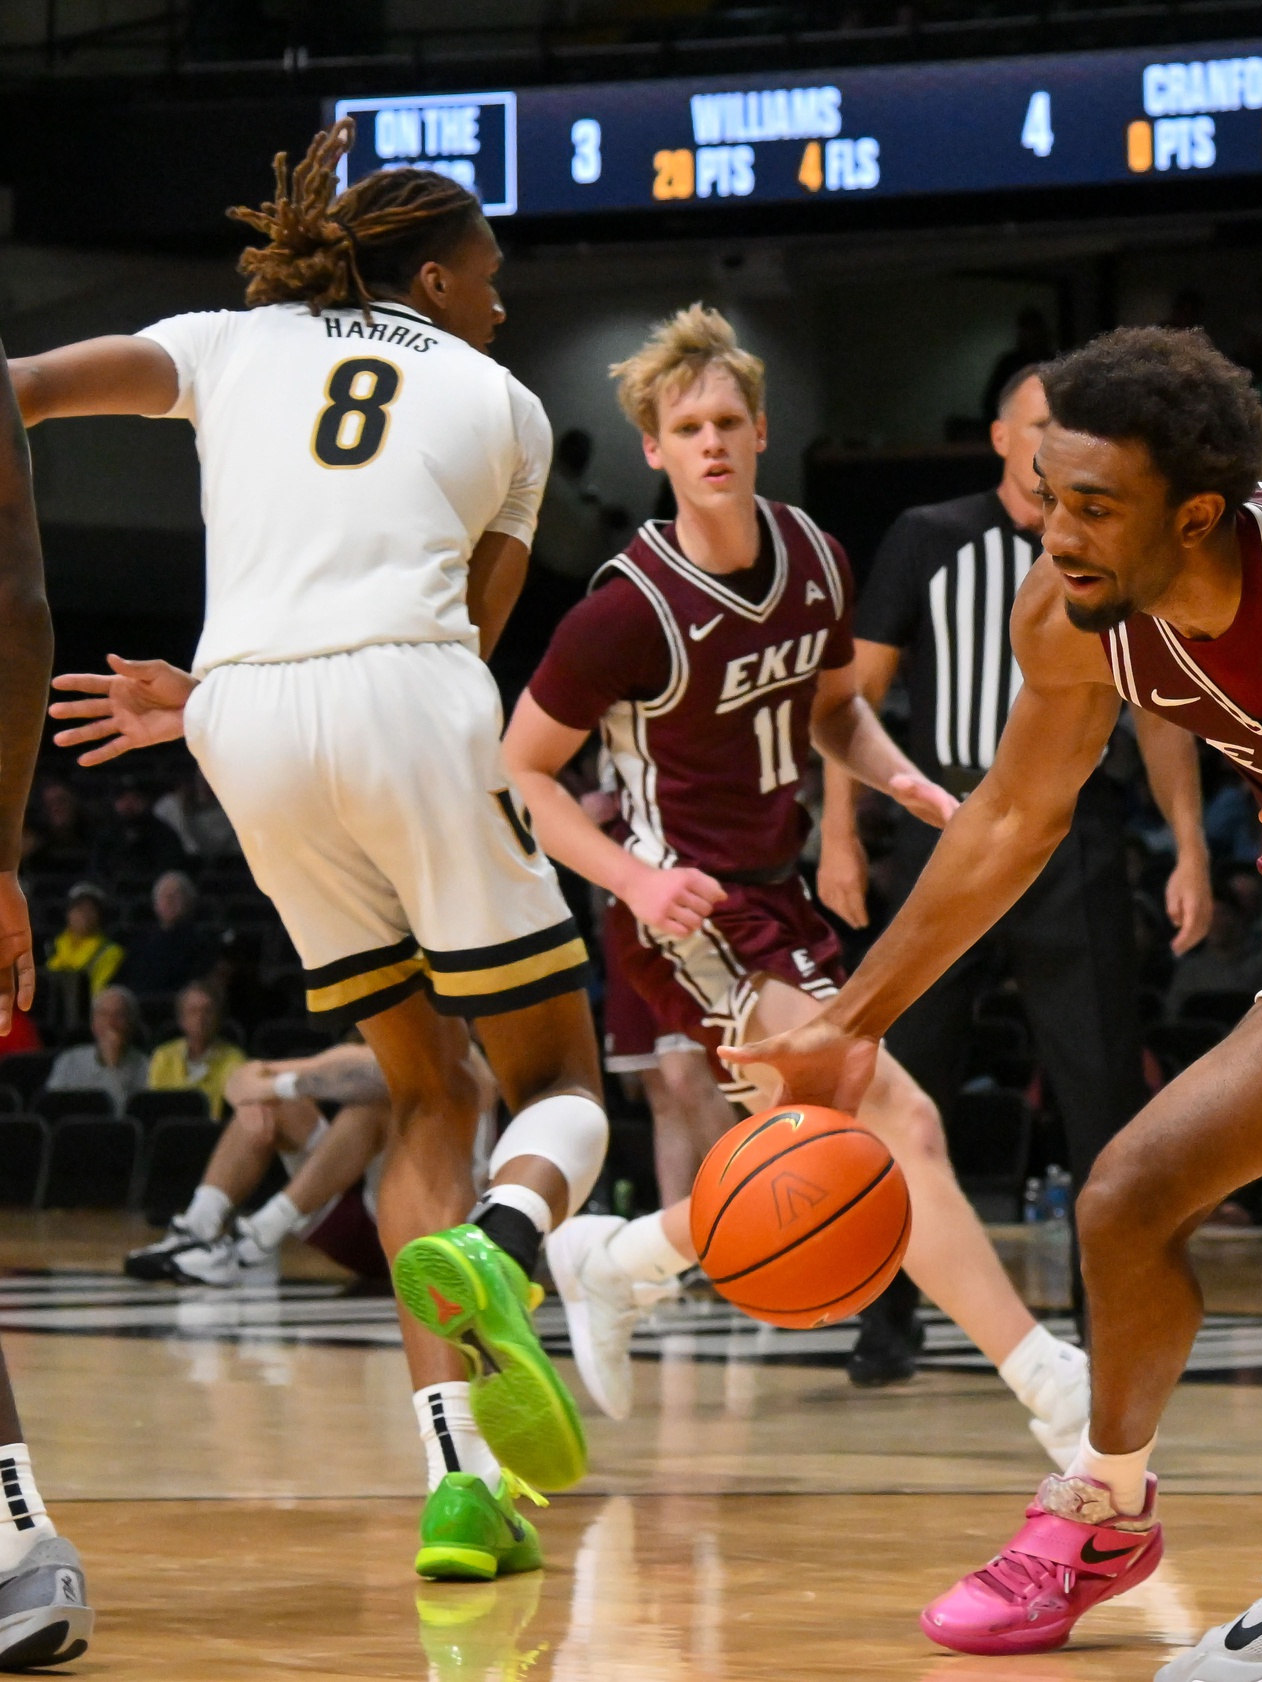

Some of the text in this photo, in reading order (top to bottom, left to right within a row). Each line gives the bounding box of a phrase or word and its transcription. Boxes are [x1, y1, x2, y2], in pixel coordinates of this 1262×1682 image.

[375, 105, 481, 158] ON THE
[690, 86, 842, 145] WILLIAMS
[1021, 91, 1054, 157] 4
[1153, 115, 1216, 171] PTS
[571, 118, 602, 184] 3
[696, 144, 755, 198] PTS
[798, 140, 823, 193] 4
[825, 136, 880, 191] FLS
[325, 317, 438, 353] HARRIS
[309, 355, 404, 470] 8
[719, 628, 829, 701] EKU
[753, 699, 799, 795] 11
